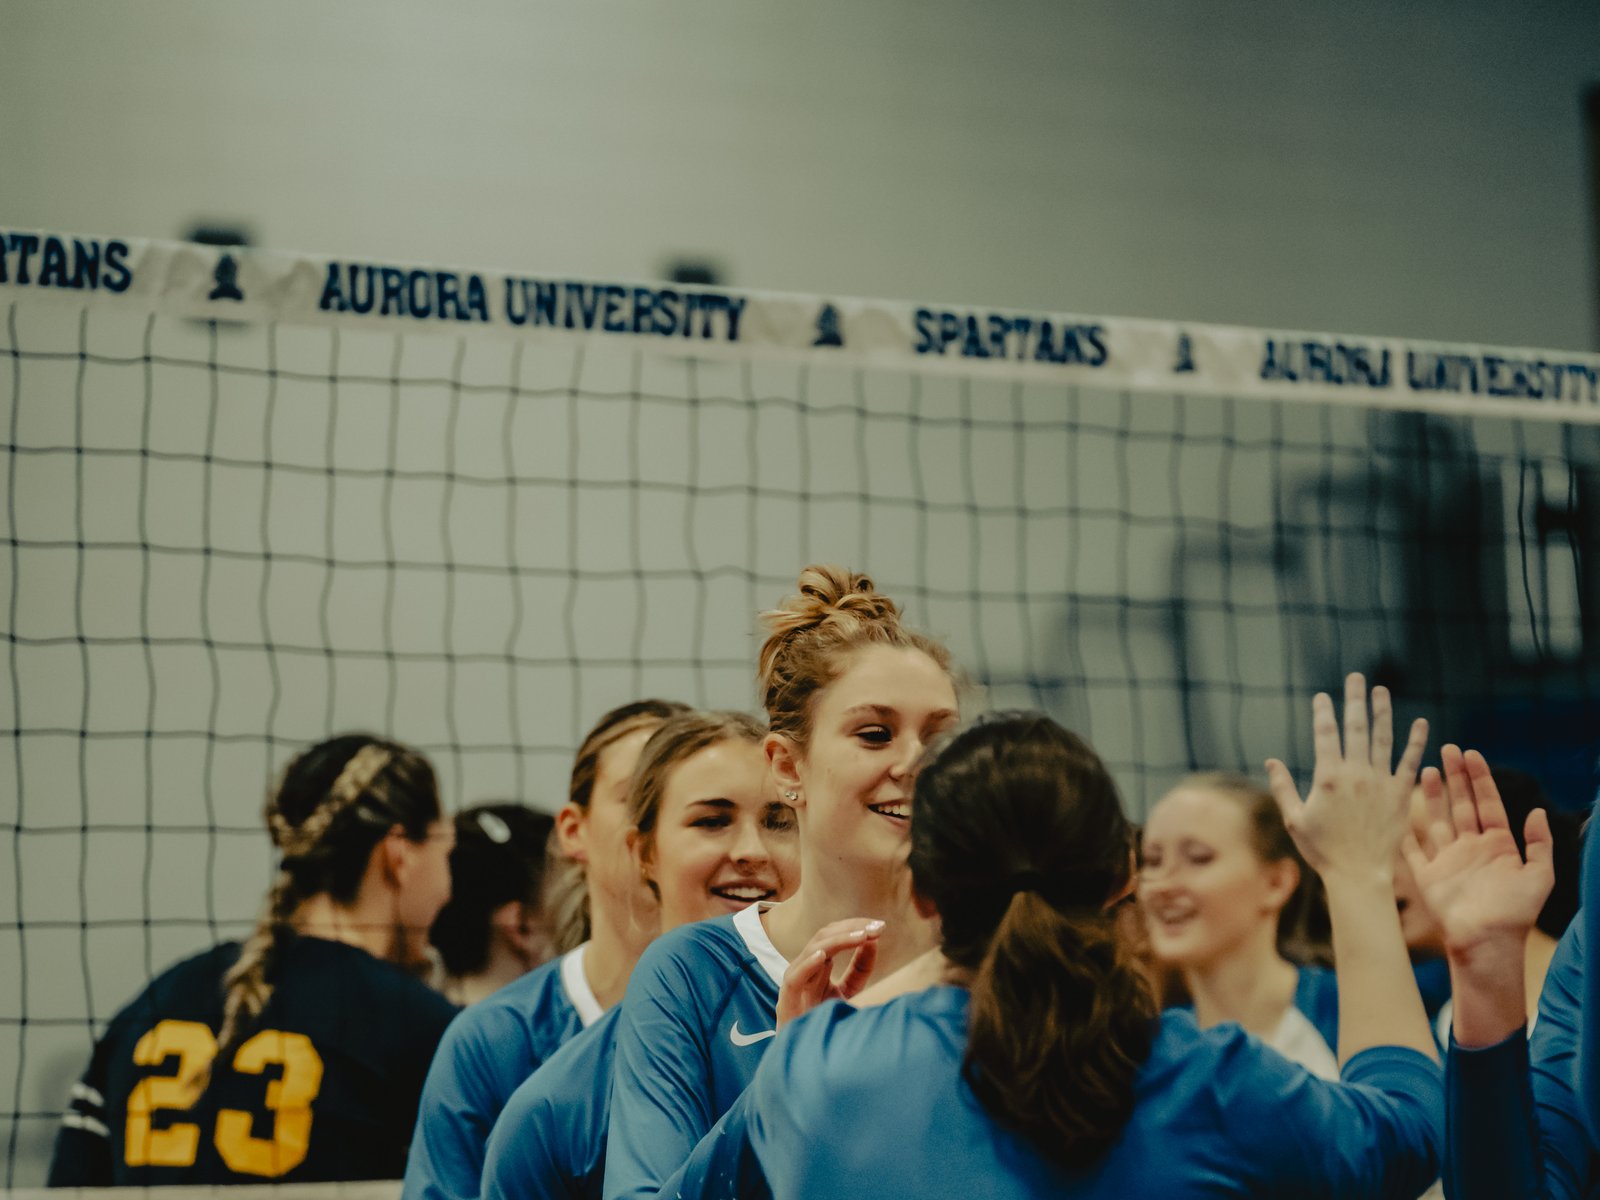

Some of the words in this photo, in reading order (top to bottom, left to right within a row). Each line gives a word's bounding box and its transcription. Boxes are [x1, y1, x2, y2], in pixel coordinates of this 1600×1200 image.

[0, 233, 132, 293] TANS
[319, 261, 489, 322] AURORA
[504, 277, 746, 341] UNIVERSITY
[914, 309, 1108, 367] SPARTANS
[124, 1018, 324, 1178] 23
